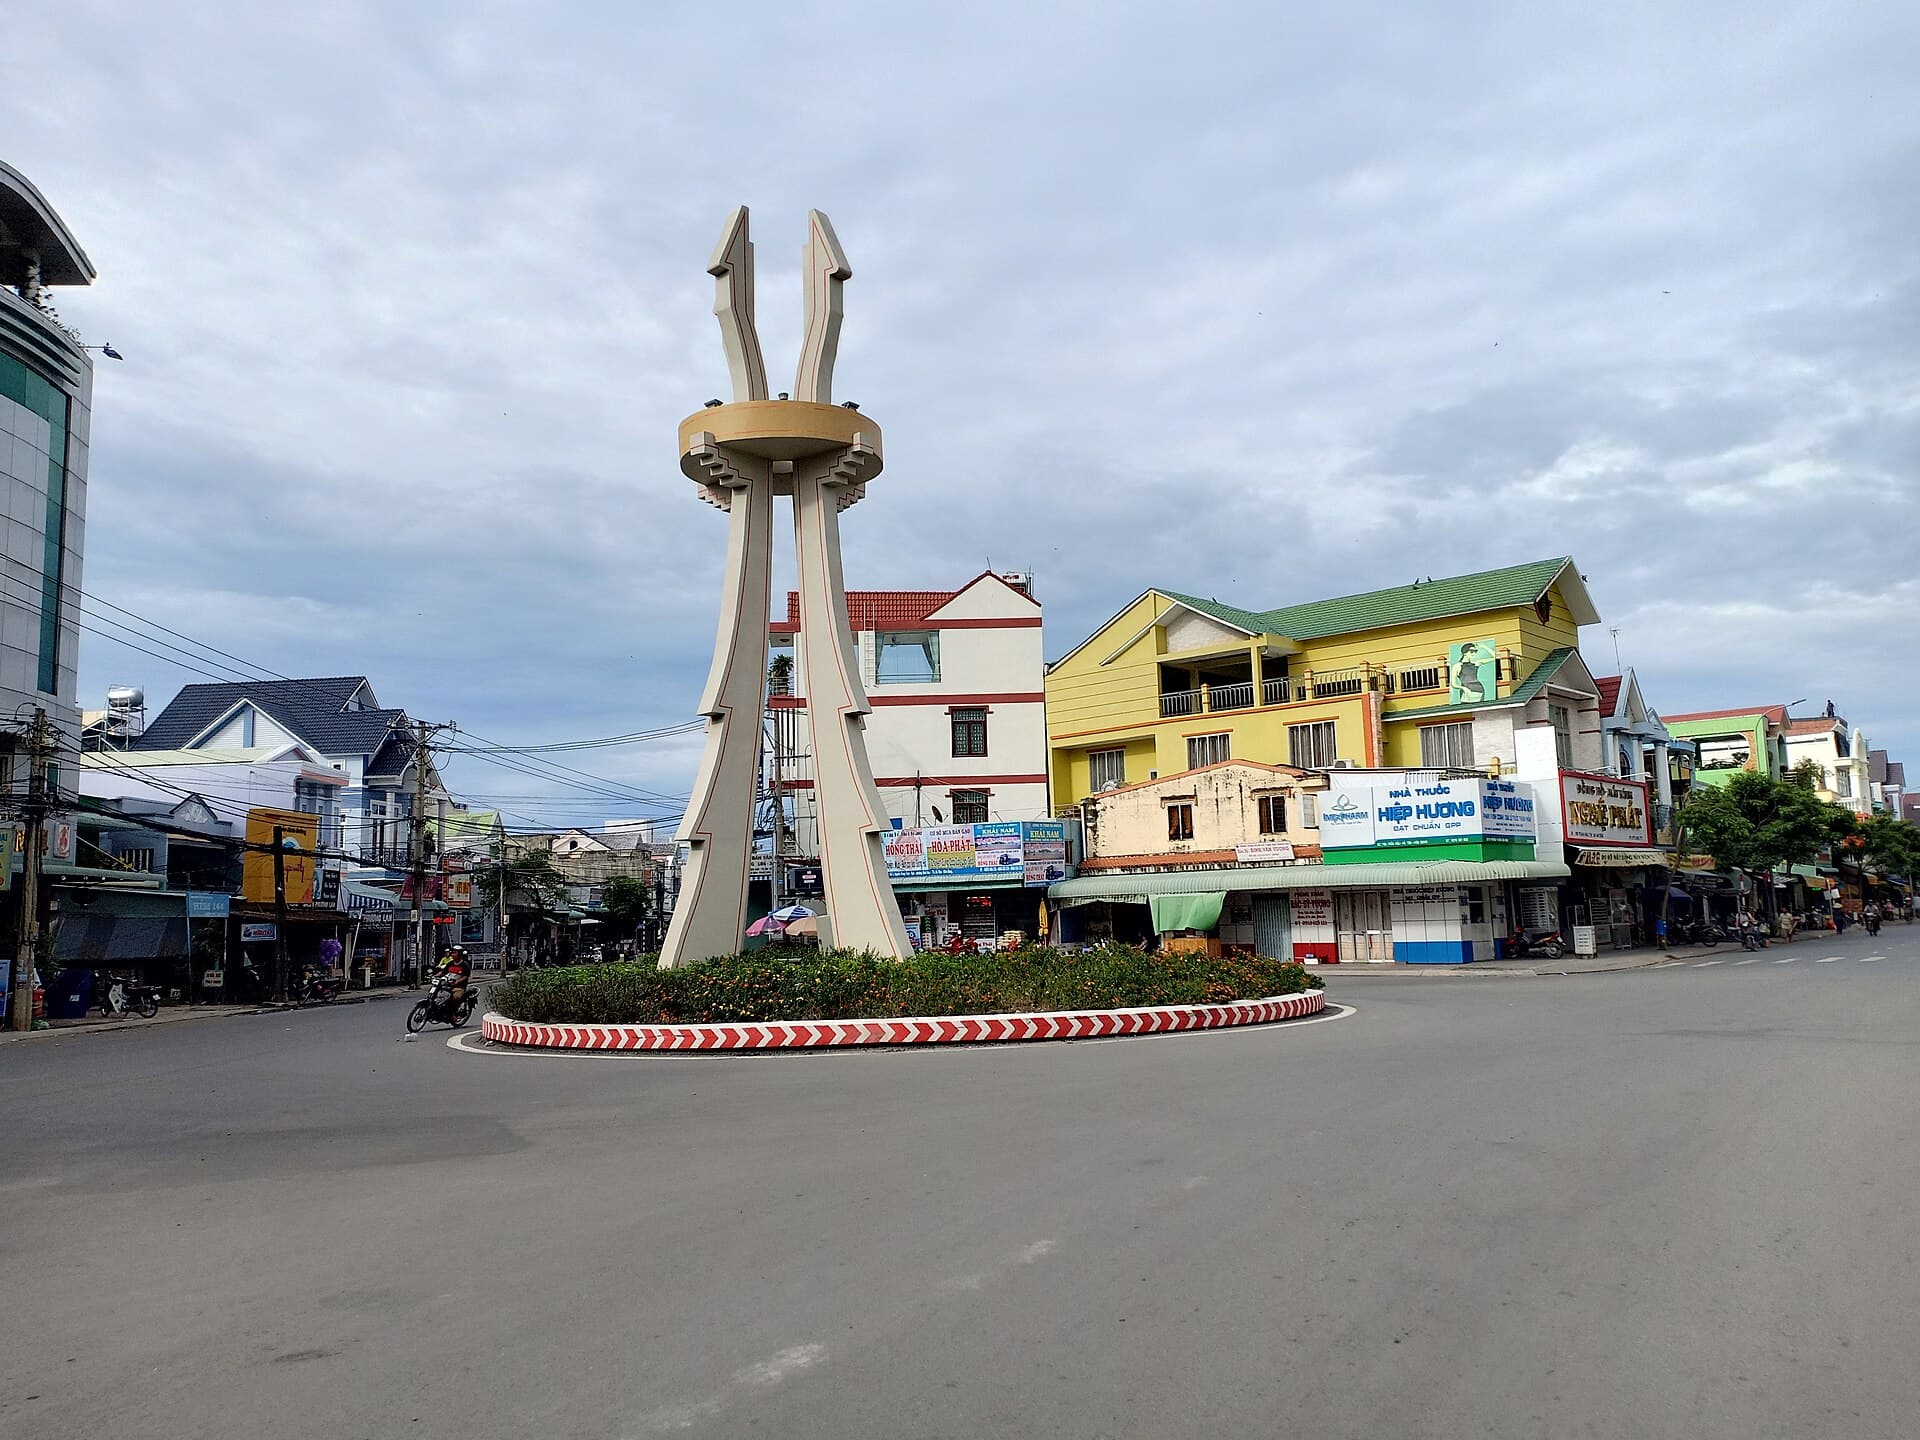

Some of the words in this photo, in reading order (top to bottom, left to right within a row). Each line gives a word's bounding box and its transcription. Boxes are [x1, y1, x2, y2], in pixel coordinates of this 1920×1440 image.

[1390, 787, 1411, 799] NHÀ
[1415, 783, 1450, 797] THUỐC
[1483, 792, 1503, 813] HIỆP
[1504, 796, 1534, 812] HƯƠNG
[1378, 801, 1412, 824] HIỆP
[1416, 801, 1475, 819] HƯƠNG
[1001, 826, 1015, 834] NAM
[1445, 821, 1462, 829] GPP
